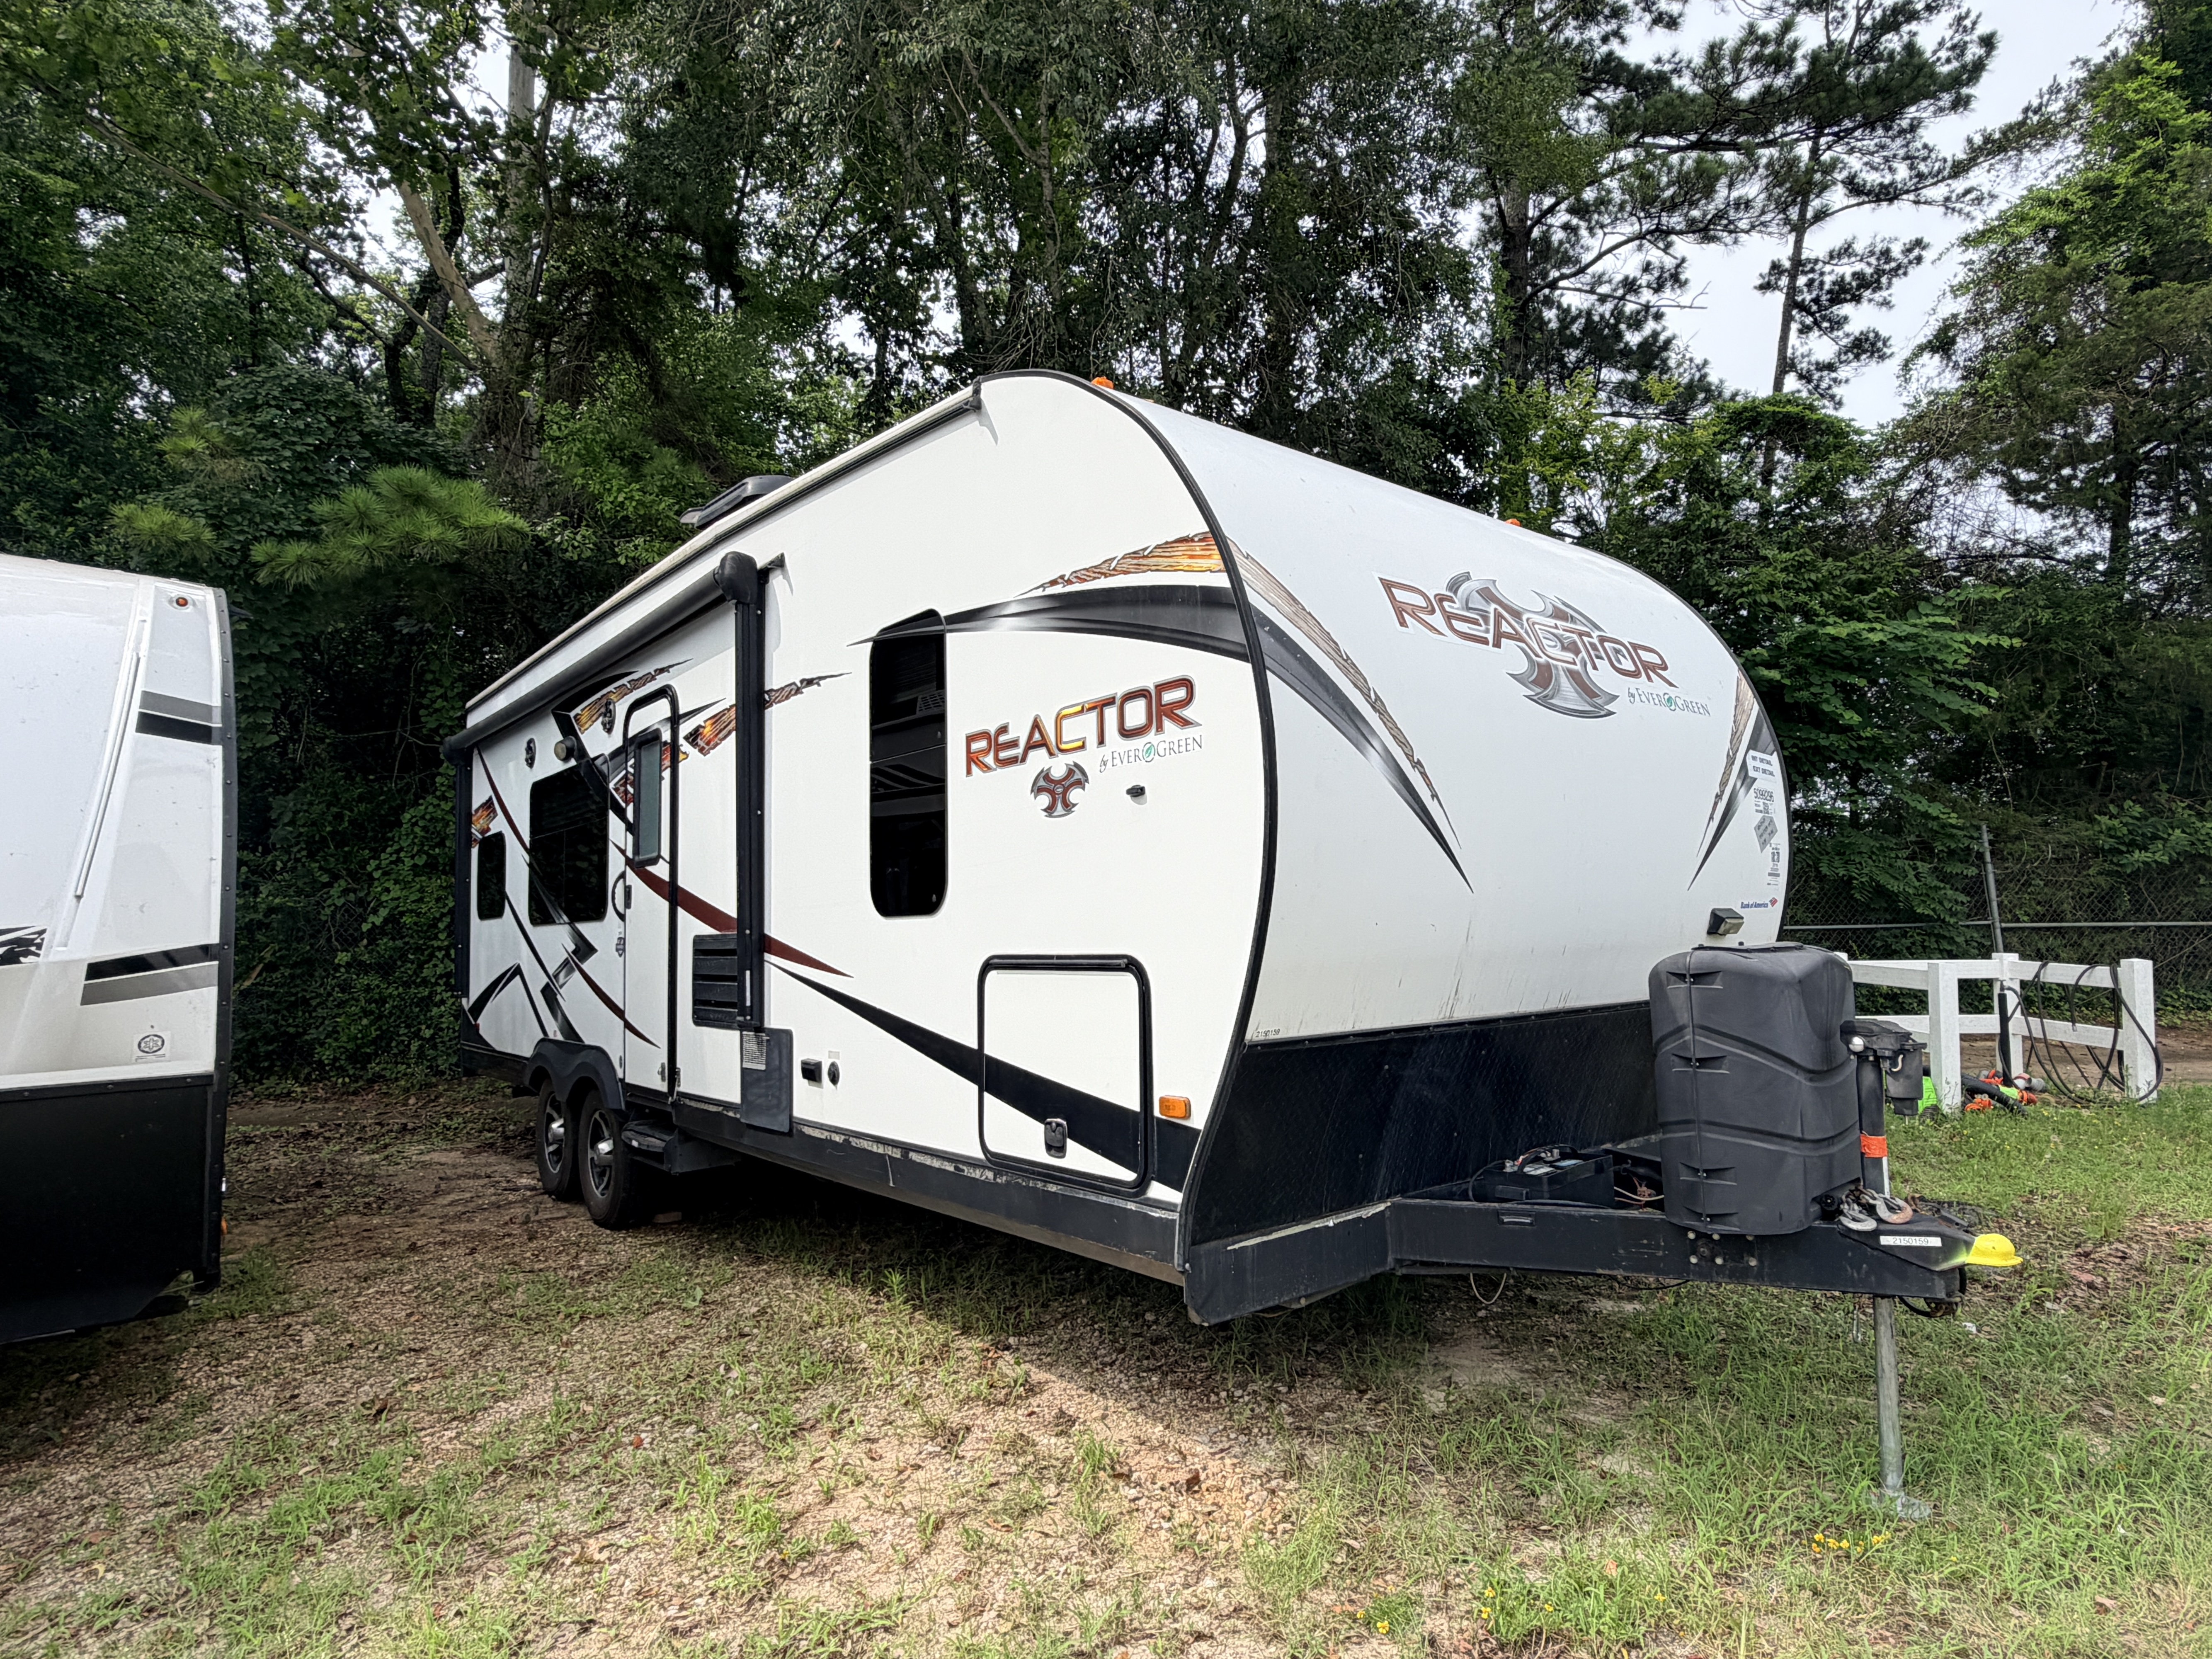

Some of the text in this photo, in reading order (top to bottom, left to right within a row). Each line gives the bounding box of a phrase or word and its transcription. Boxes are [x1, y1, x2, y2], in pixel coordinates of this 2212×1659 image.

[1377, 576, 1678, 688] REACTOR
[965, 674, 1202, 777] REACTOR
[1627, 687, 1635, 704] by
[1099, 754, 1108, 773] by
